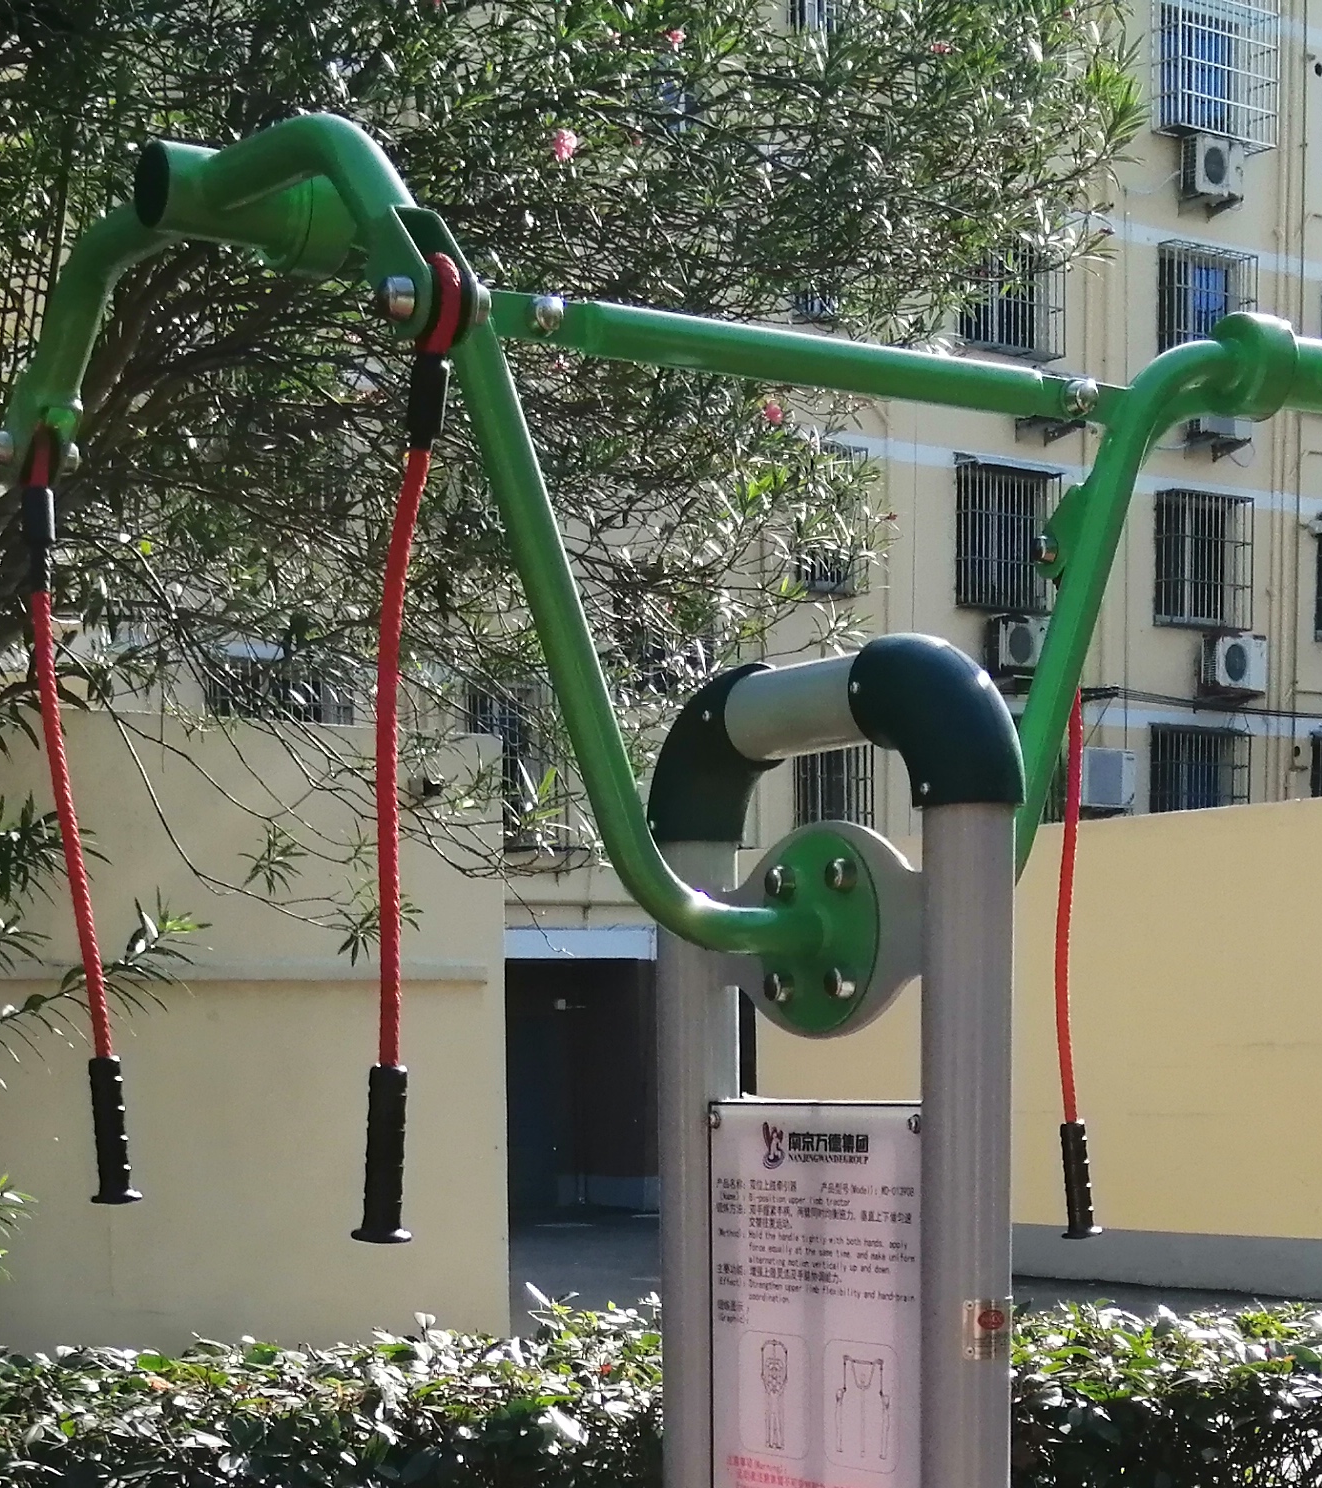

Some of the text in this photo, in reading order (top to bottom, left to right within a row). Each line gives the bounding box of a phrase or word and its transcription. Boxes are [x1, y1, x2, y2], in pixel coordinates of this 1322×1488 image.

[788, 1131, 869, 1153] 南京万德集团
